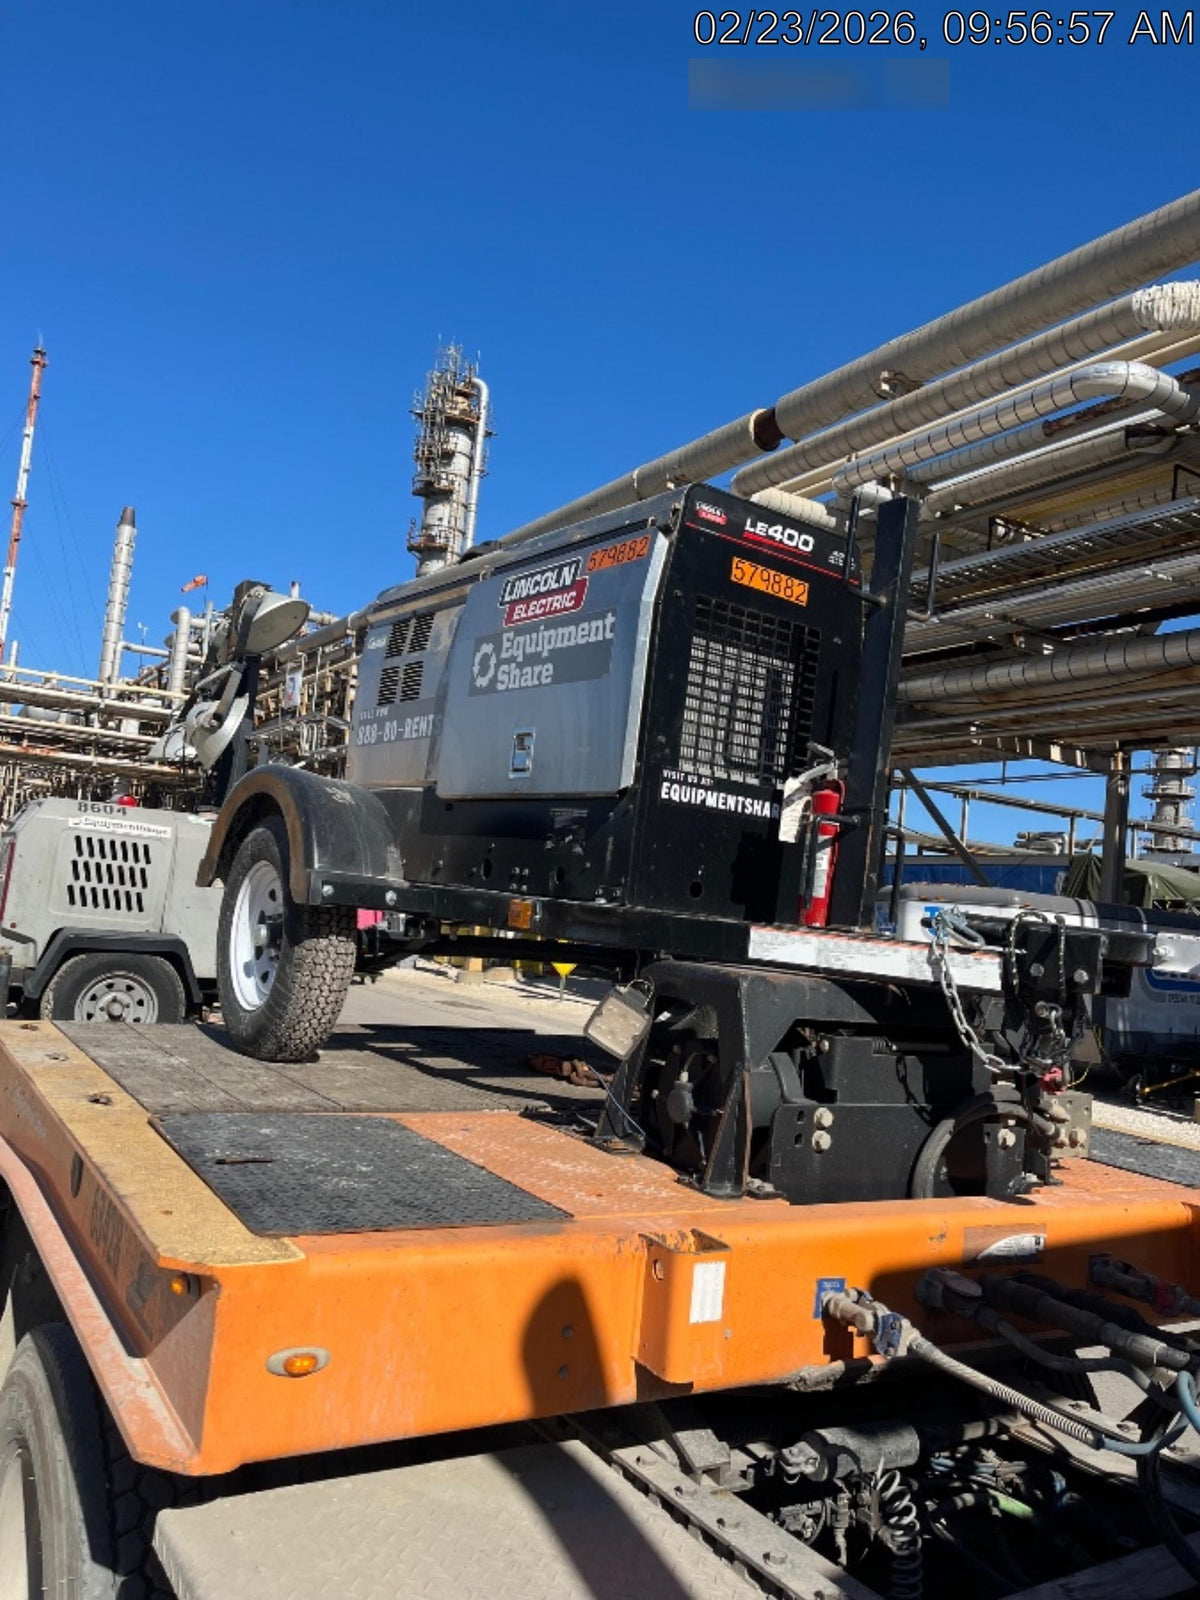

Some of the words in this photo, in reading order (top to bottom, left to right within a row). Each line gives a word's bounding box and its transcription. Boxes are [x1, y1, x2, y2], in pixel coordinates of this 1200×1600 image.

[745, 518, 815, 552] LE400
[587, 536, 650, 572] 579882
[503, 563, 577, 603] LINCOLN
[733, 559, 807, 604] 579882
[511, 591, 577, 621] ELECTRIC
[500, 611, 616, 662] Equipment
[496, 662, 554, 690] Share
[662, 768, 685, 781] VISIT
[77, 801, 127, 816] 8604
[660, 781, 780, 818] EQUIPMENTSHAR
